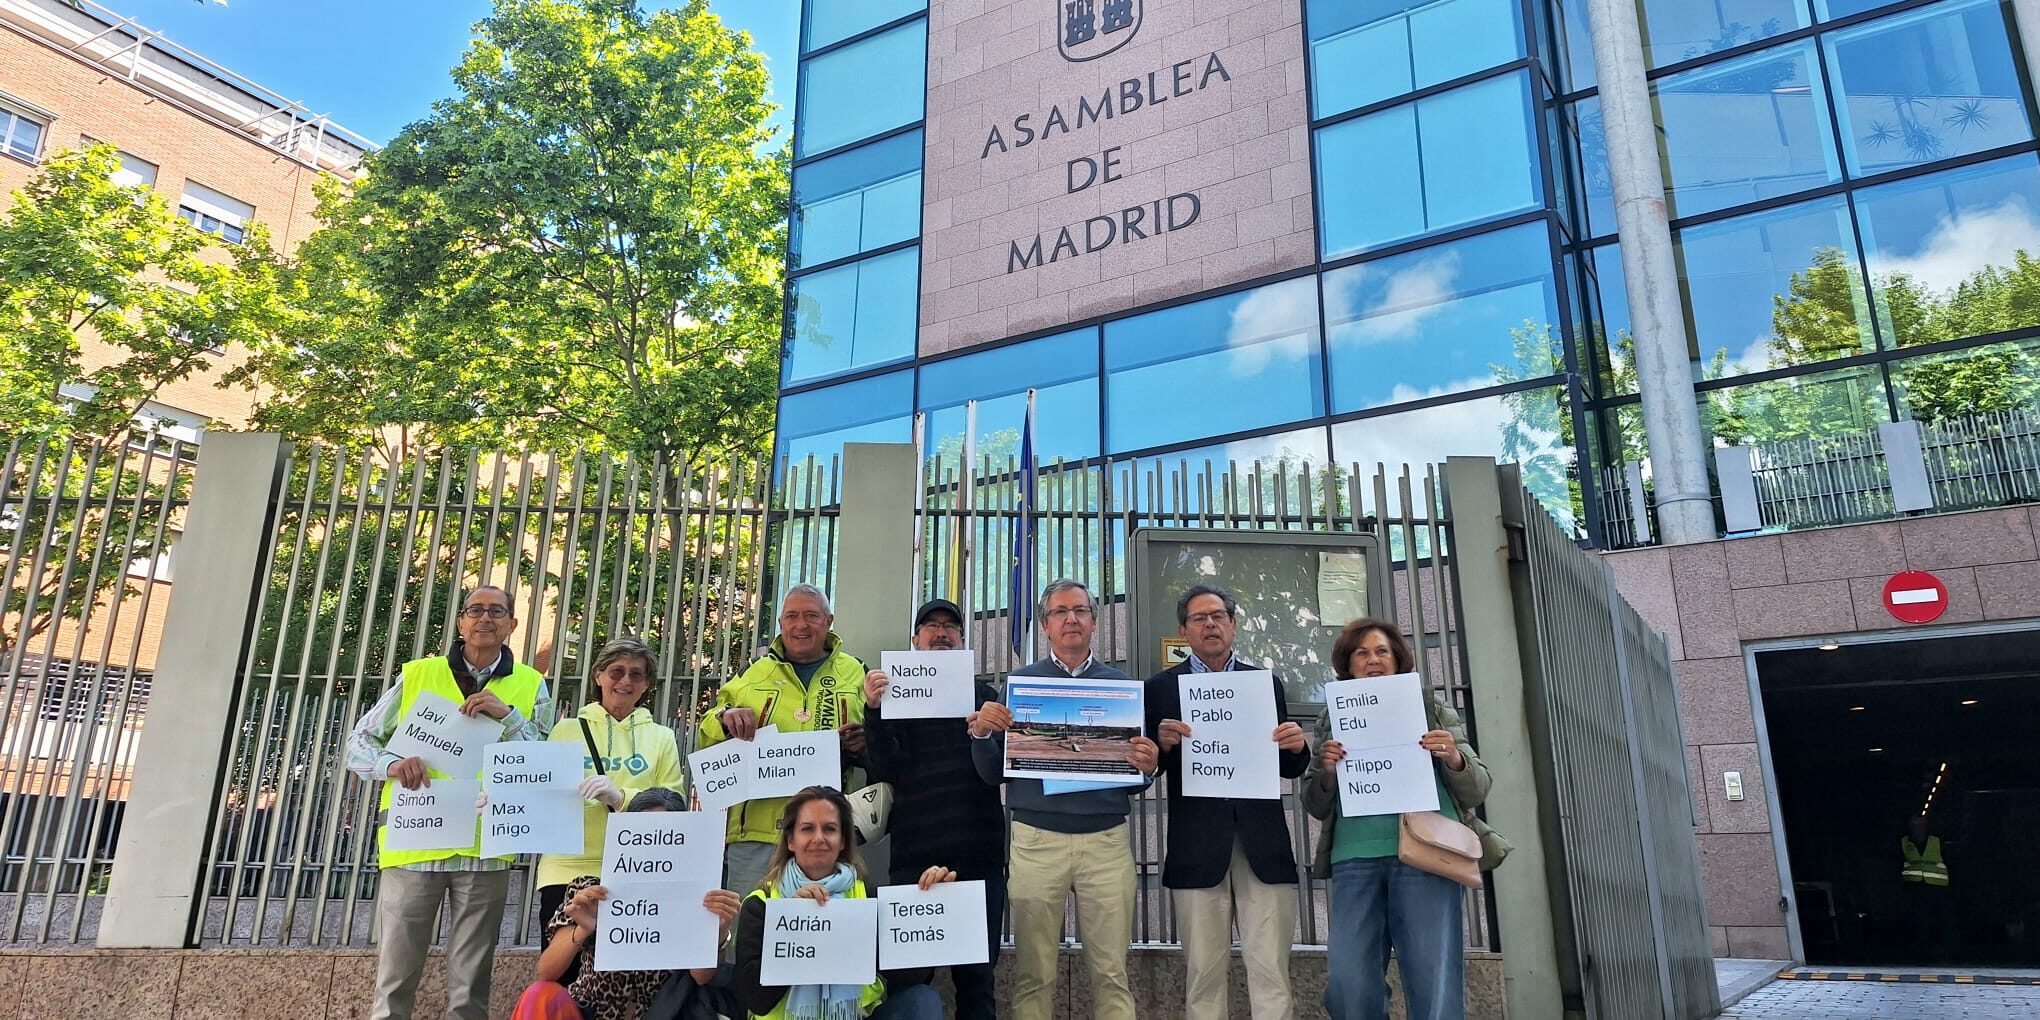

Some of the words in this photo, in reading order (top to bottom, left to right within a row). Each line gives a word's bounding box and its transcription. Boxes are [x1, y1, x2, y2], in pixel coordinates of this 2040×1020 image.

[980, 51, 1232, 159] ASAMBLEA
[1068, 146, 1122, 194] DE
[1006, 191, 1202, 274] MADRID
[892, 664, 937, 678] Nacho
[892, 686, 933, 699] Samu
[1190, 688, 1235, 702] Mateo
[1336, 693, 1379, 710] Emilia
[417, 706, 448, 726] Javi
[1191, 708, 1233, 723] Pablo
[1339, 717, 1368, 732] Edu
[404, 722, 464, 757] Manuela
[1192, 740, 1230, 755] Sofía
[494, 754, 525, 766] Noa
[759, 745, 816, 760] Leandro
[700, 751, 742, 775] Paula
[1192, 762, 1236, 781] Romy
[1344, 755, 1393, 775] Filippo
[493, 771, 552, 784] Samuel
[759, 766, 796, 780] Milan
[706, 774, 739, 794] Ceci
[1349, 781, 1381, 796] Nico
[396, 792, 436, 807] Simón
[493, 803, 526, 817] Max
[395, 816, 443, 829] Susana
[493, 824, 531, 838] Iñigo
[618, 829, 685, 846] Casilda
[613, 852, 673, 874] Álvaro
[610, 899, 660, 918] Sofía
[889, 902, 945, 918] Teresa
[776, 915, 832, 932] Adrián
[609, 927, 661, 945] Olivia
[890, 926, 945, 944] Tomás
[775, 942, 816, 959] Elisa
